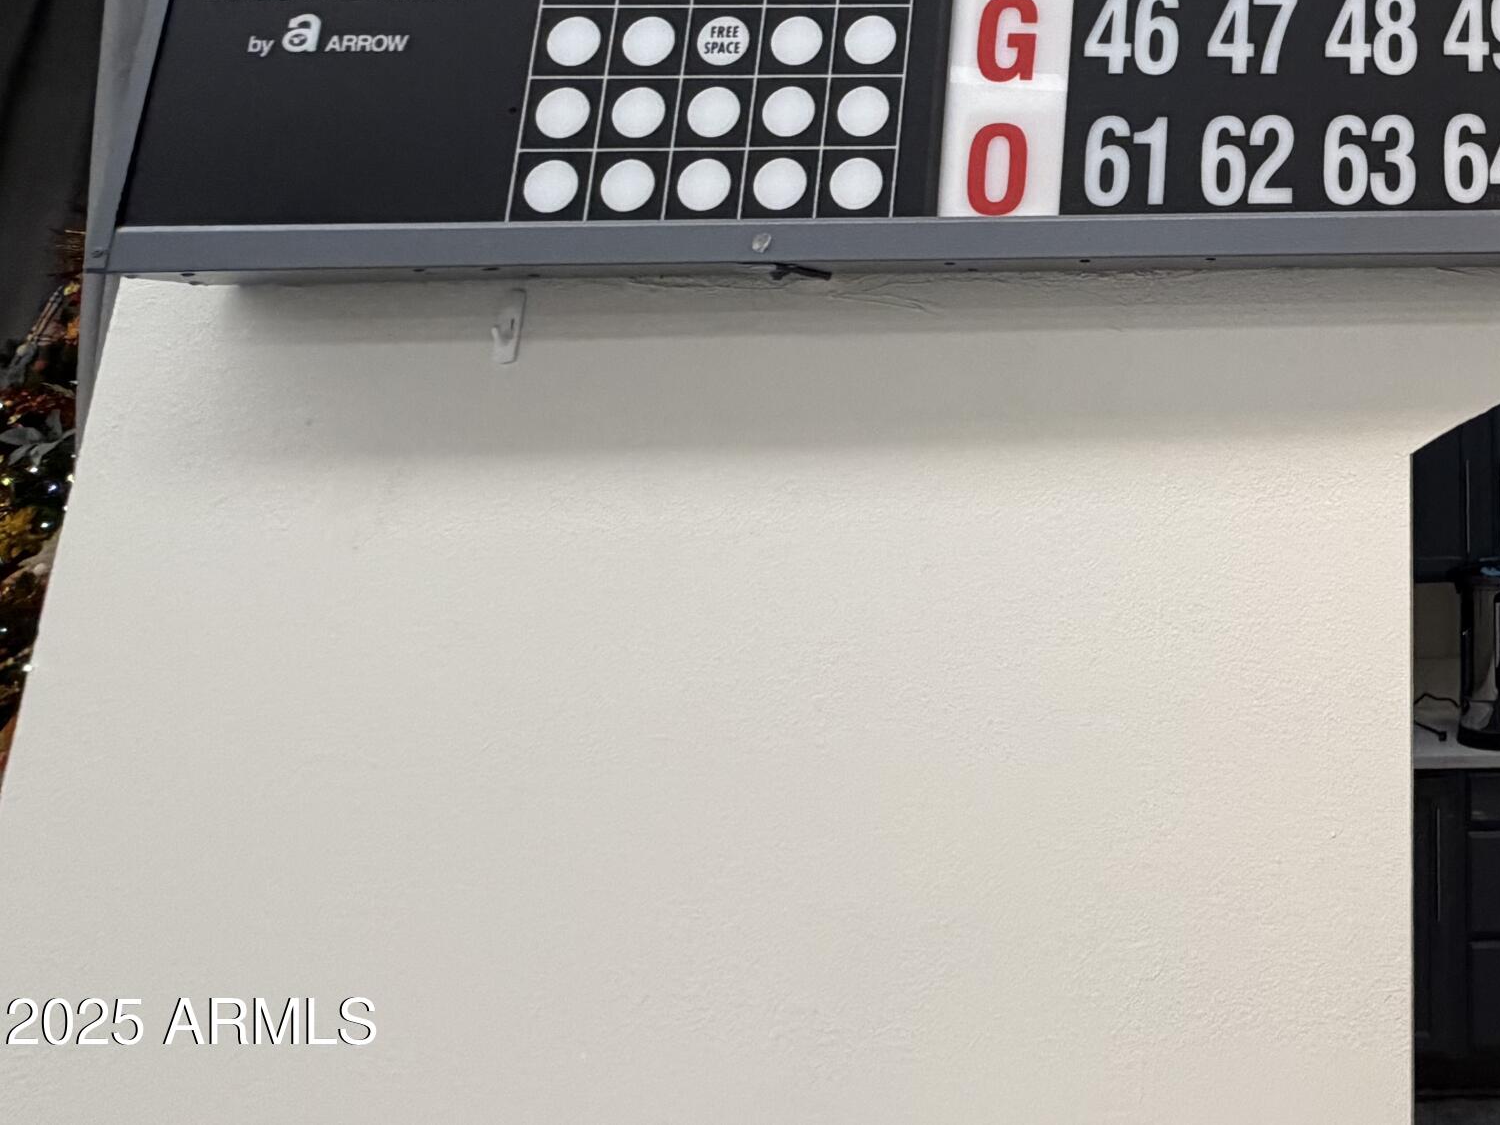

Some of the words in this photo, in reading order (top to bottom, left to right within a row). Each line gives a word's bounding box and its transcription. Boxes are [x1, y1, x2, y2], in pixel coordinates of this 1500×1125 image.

[710, 26, 740, 38] FREE
[247, 35, 274, 57] by
[324, 34, 409, 53] ARROW
[704, 42, 741, 54] SPACE
[1084, 115, 1168, 207] 61
[1200, 114, 1295, 207] 62
[1323, 114, 1417, 206] 63
